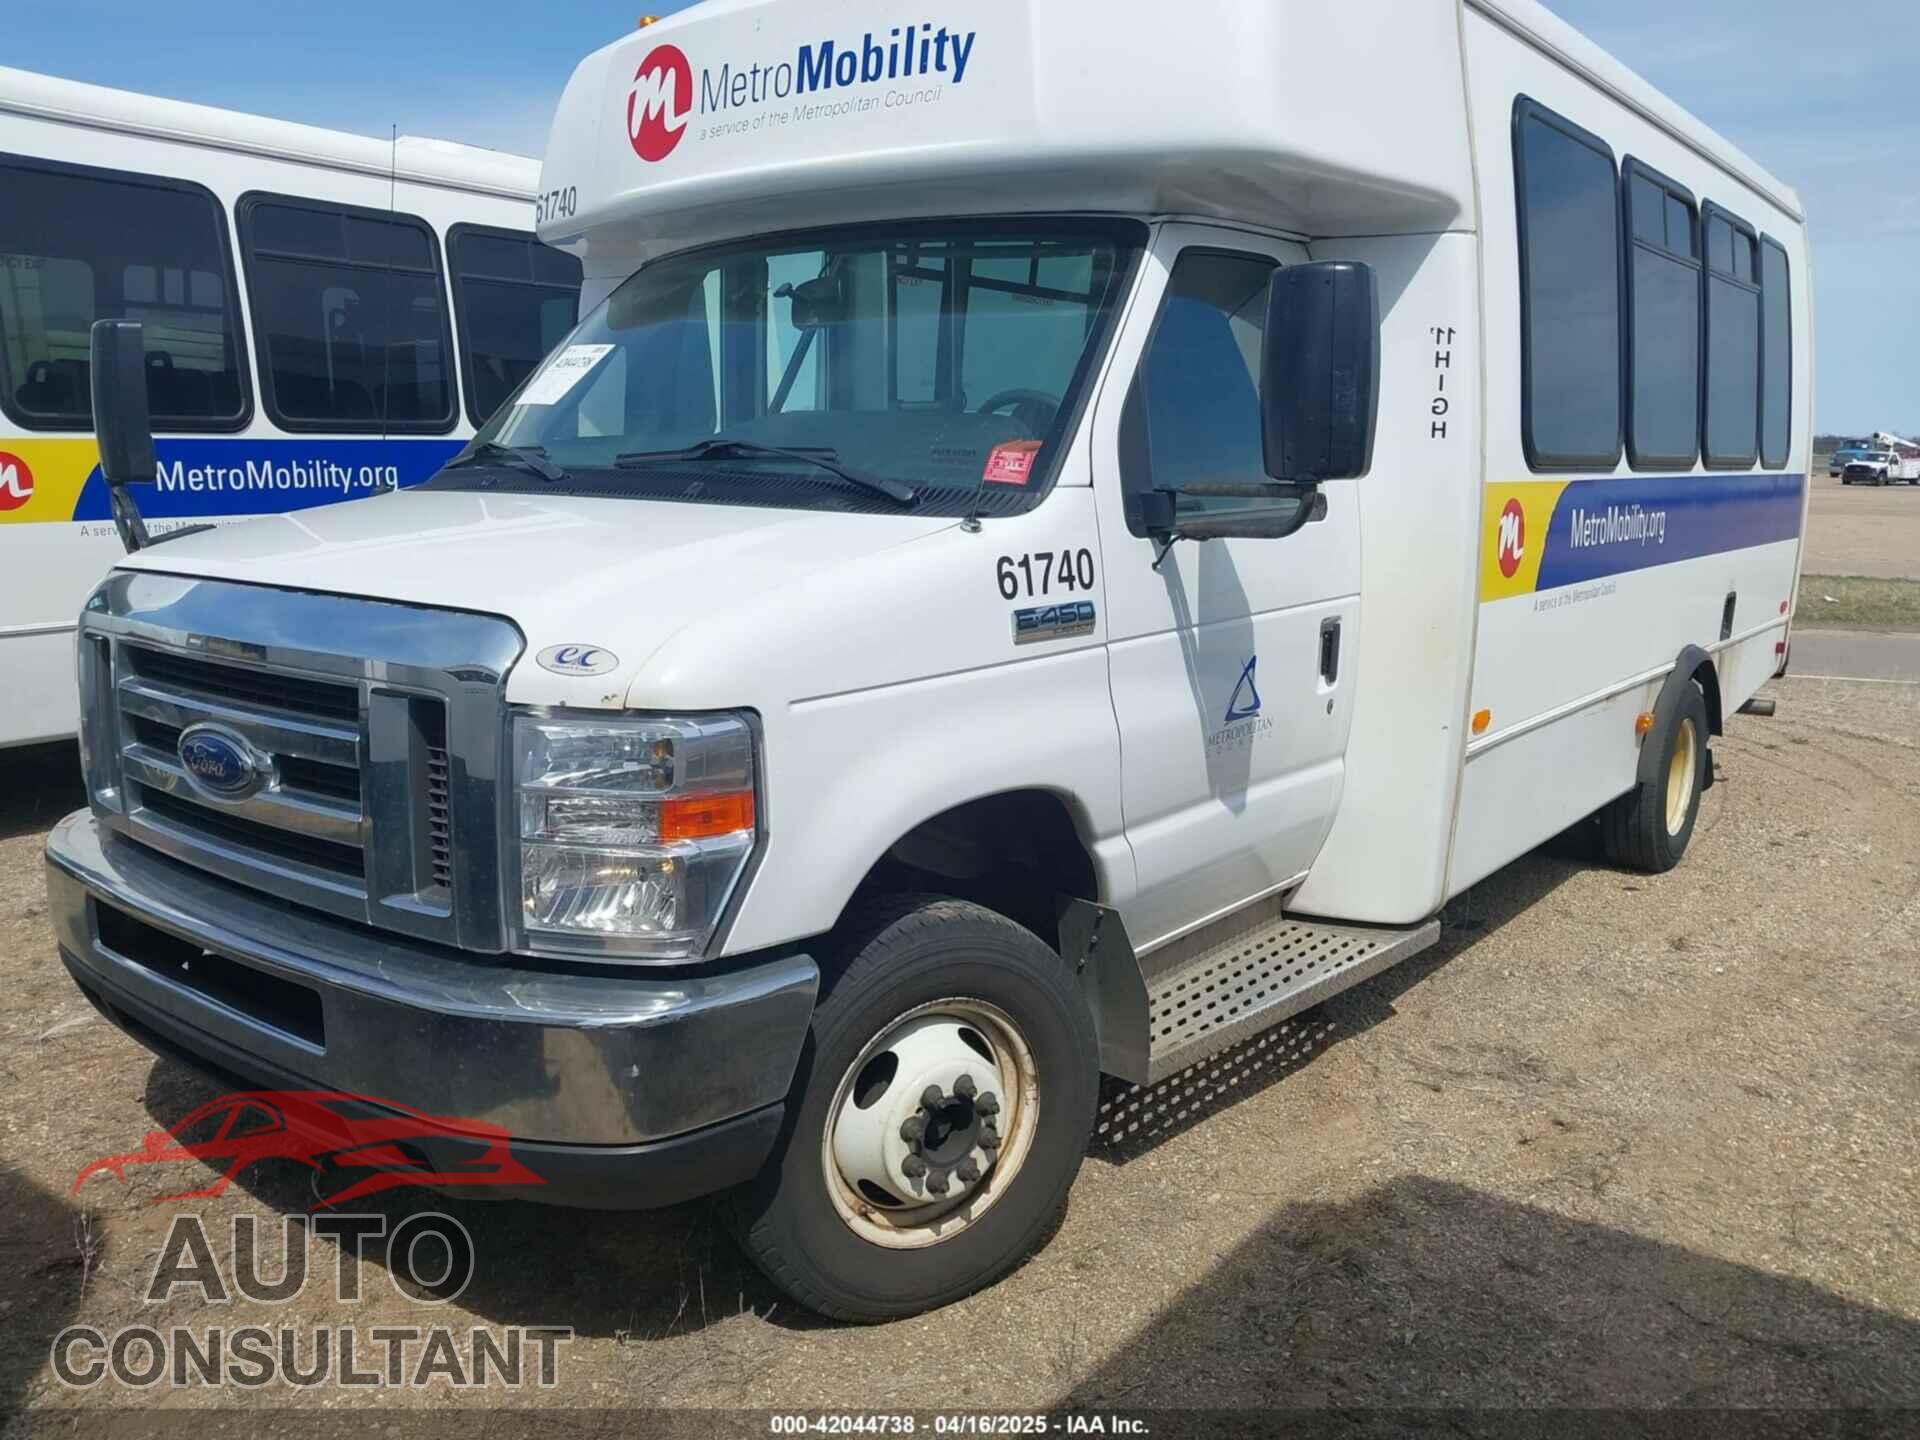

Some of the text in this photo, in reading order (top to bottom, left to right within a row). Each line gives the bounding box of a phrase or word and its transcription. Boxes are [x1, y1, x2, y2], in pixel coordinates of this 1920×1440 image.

[701, 23, 976, 115] MetroMobility
[700, 85, 943, 141] a service of the Metropolitan Council
[537, 186, 577, 224] 61740
[156, 460, 398, 494] MetroMobility.org
[1570, 504, 1666, 549] MetroMobility.org
[997, 548, 1095, 600] 61740
